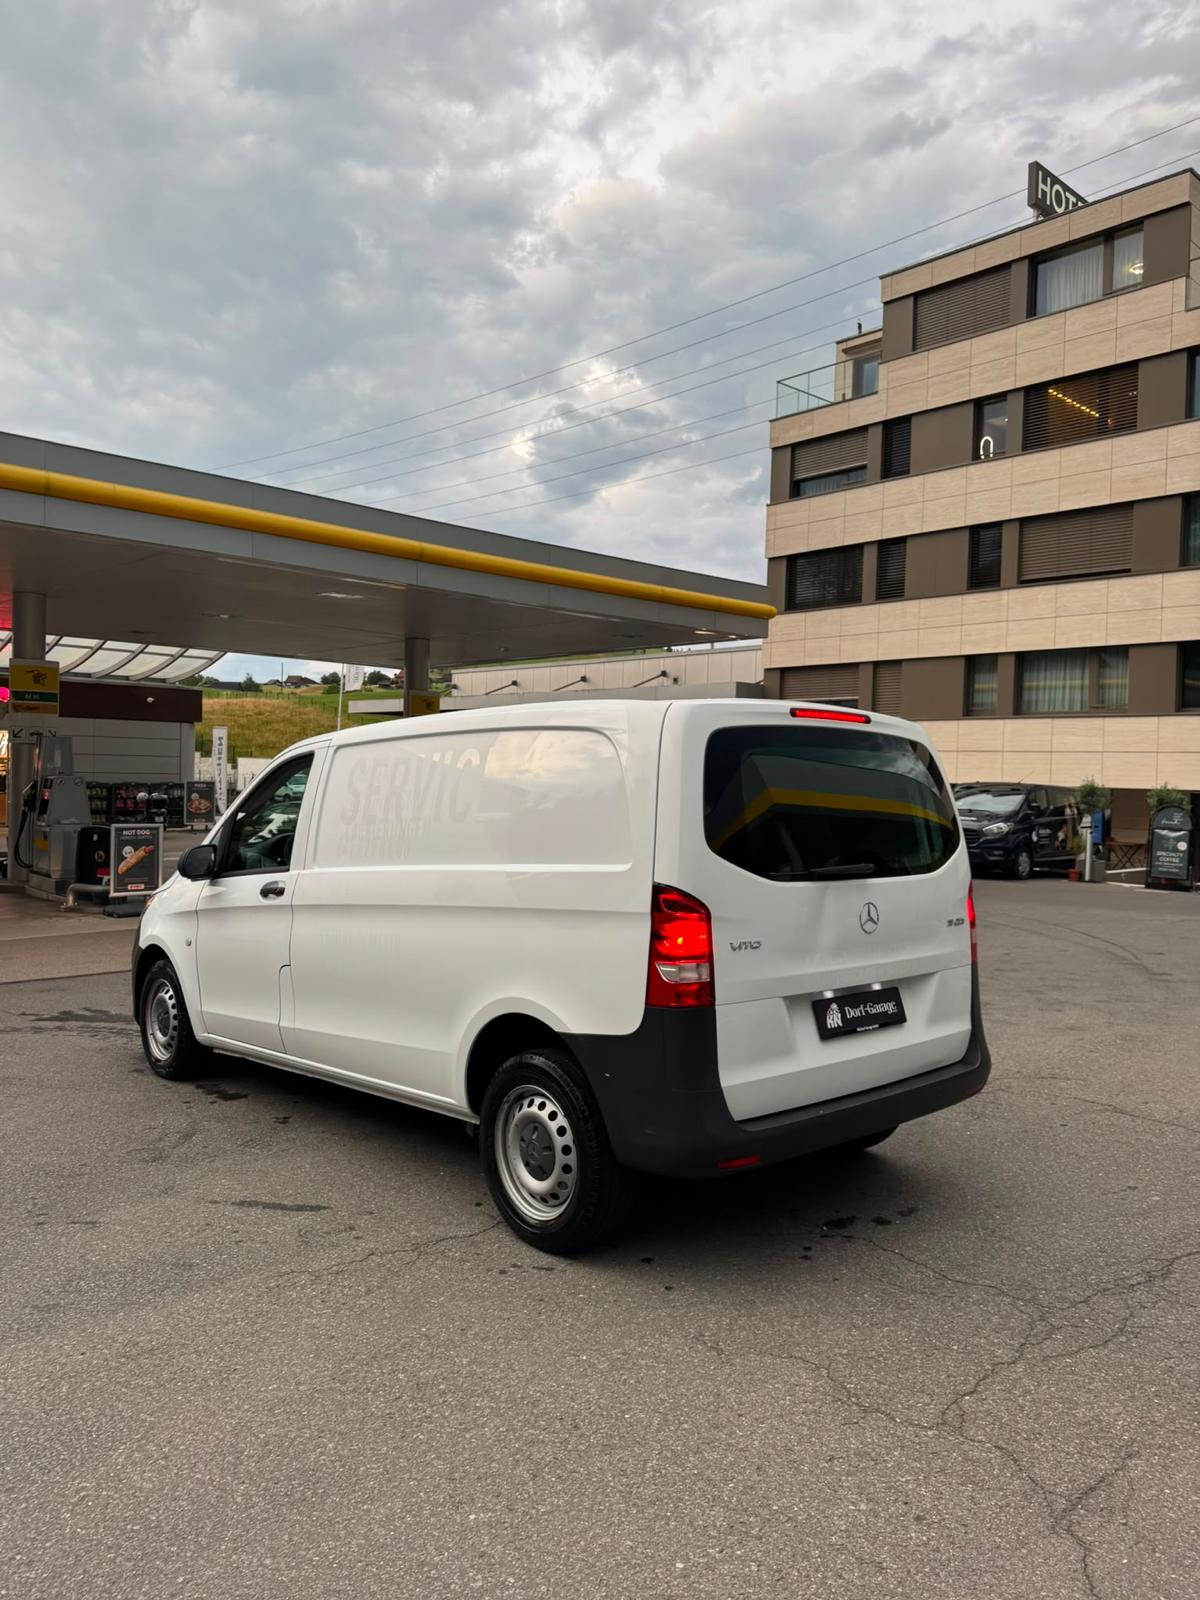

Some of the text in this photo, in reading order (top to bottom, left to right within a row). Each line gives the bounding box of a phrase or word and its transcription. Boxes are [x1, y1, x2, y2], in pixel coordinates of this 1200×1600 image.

[1038, 170, 1084, 213] HOT
[729, 940, 763, 952] VITO
[844, 1001, 898, 1019] Dorf-Garage
